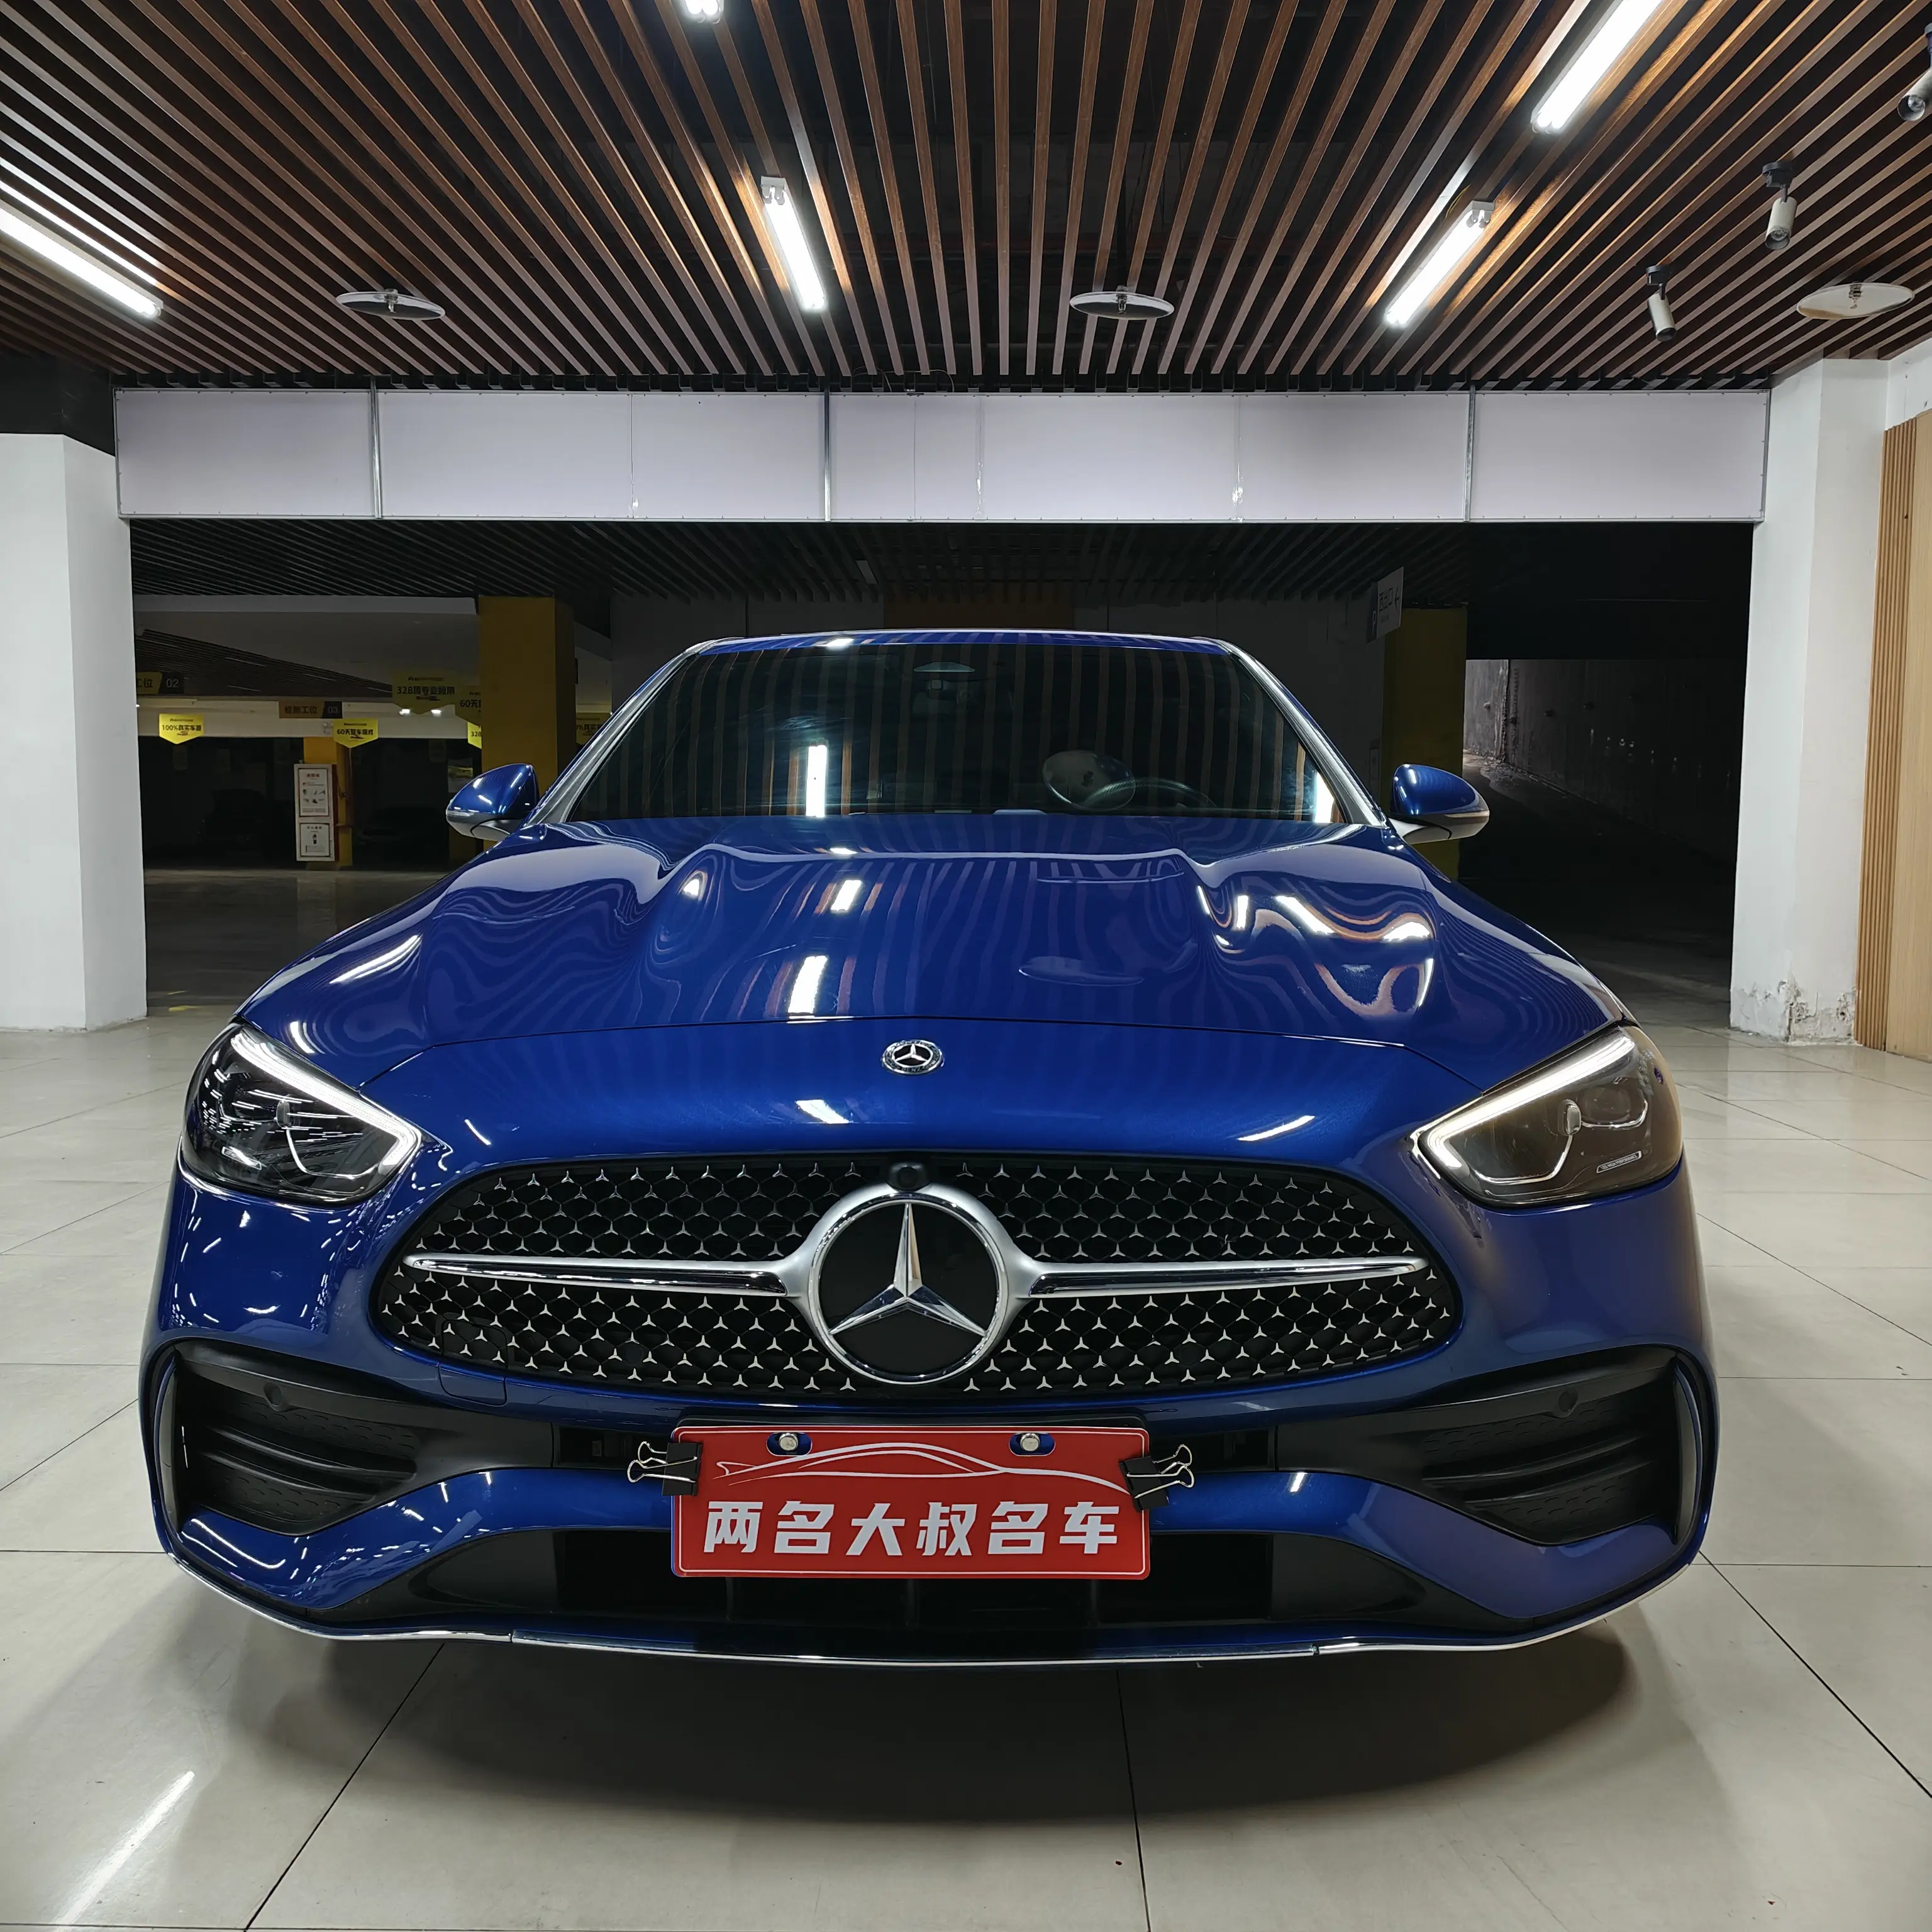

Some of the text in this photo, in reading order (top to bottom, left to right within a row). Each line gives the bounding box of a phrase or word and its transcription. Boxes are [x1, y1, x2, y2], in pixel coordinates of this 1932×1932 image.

[166, 678, 179, 688] 02
[460, 699, 482, 708] 60天
[704, 1501, 1119, 1555] 两名大叔名车
